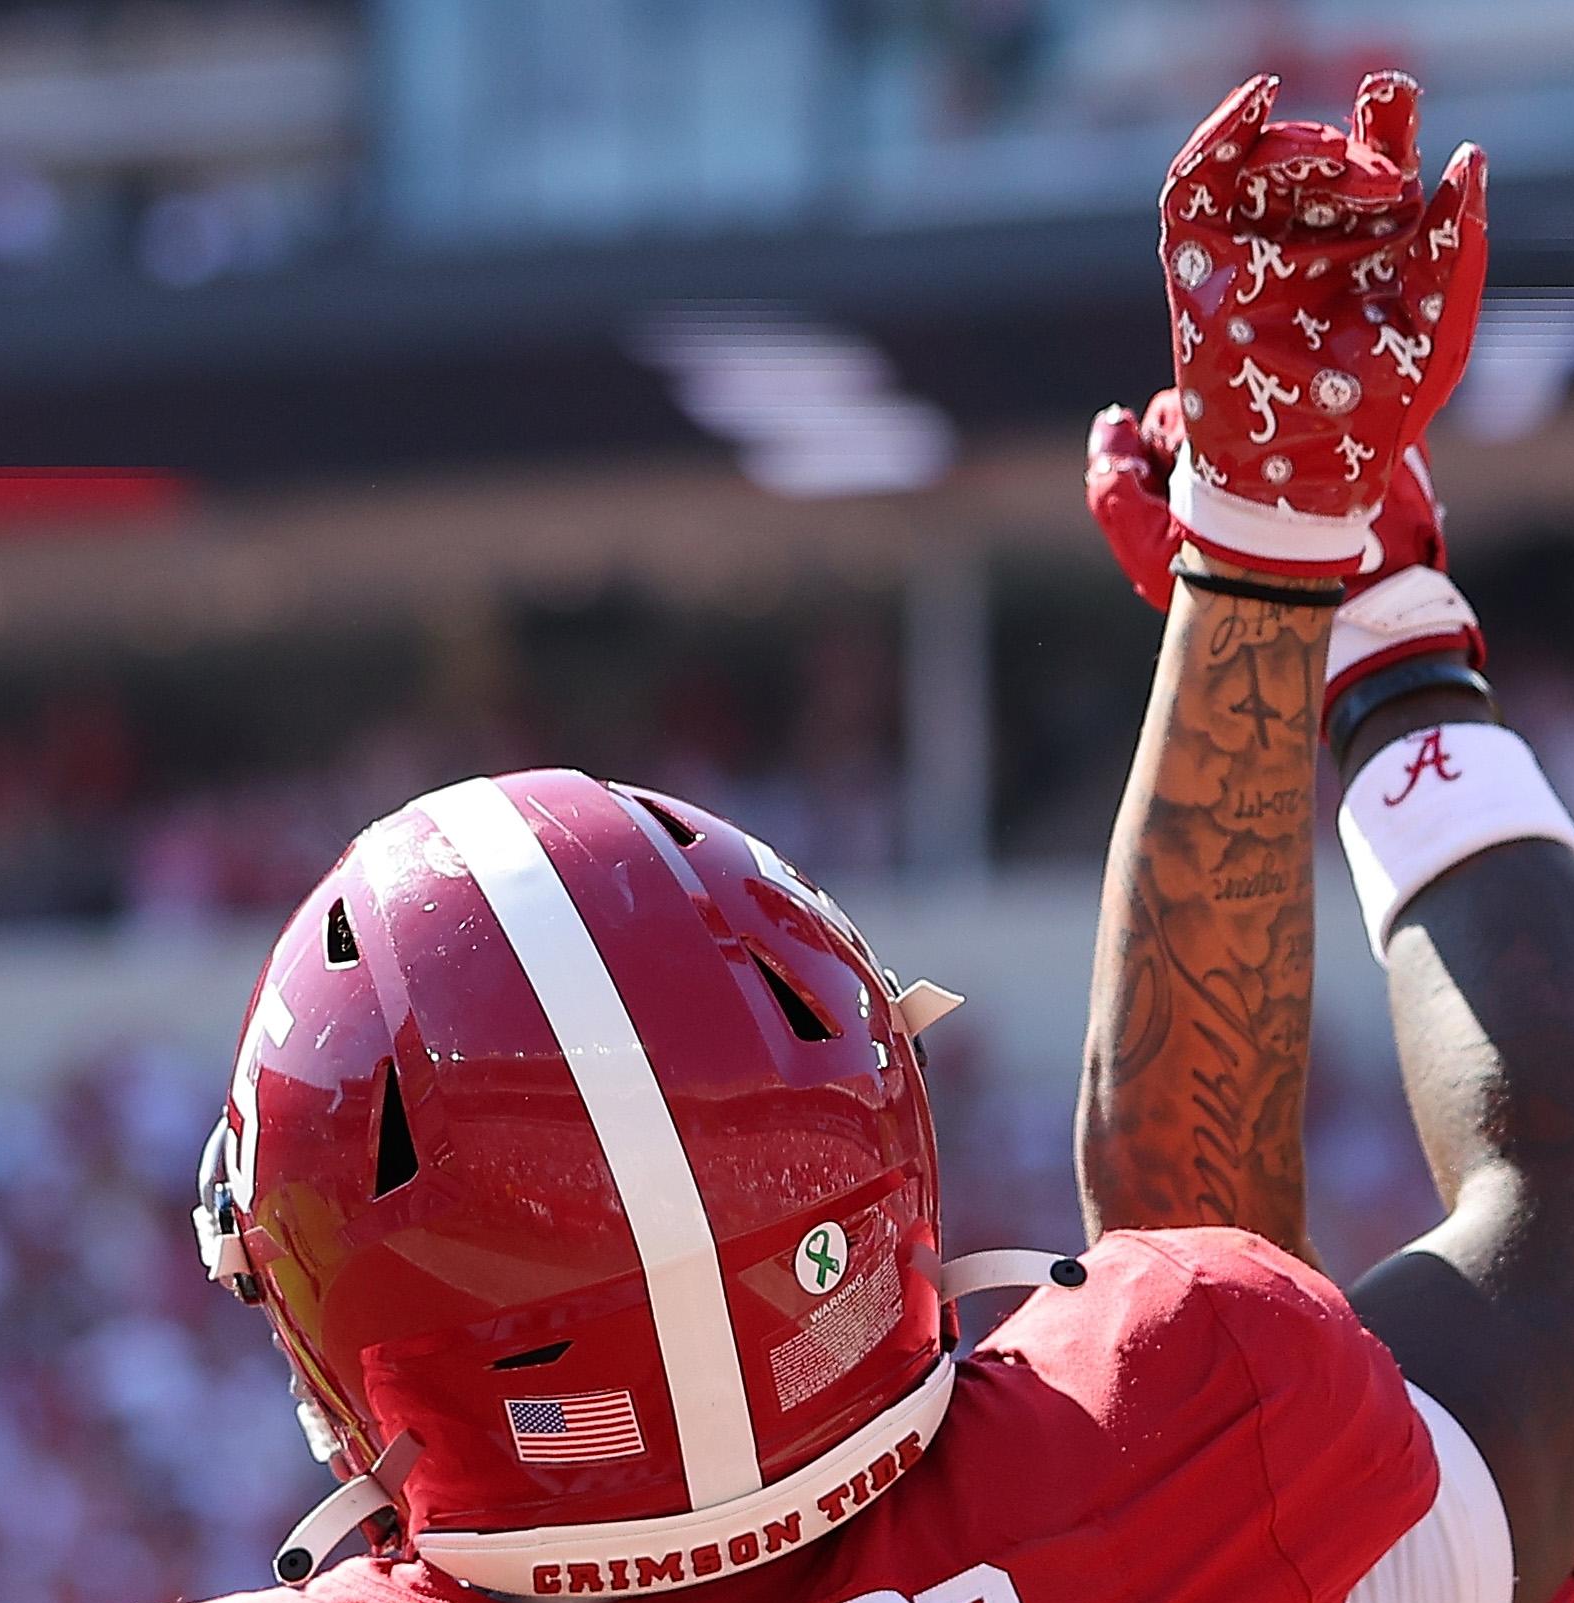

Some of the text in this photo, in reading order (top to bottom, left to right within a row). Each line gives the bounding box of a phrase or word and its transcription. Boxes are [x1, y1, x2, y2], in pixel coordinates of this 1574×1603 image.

[1232, 231, 1296, 304] A
[1229, 356, 1300, 445] A
[1334, 433, 1375, 482] A
[1383, 727, 1463, 807] A
[809, 1273, 866, 1324] WARNING
[532, 1430, 925, 1595] CRIMSON TIDE
